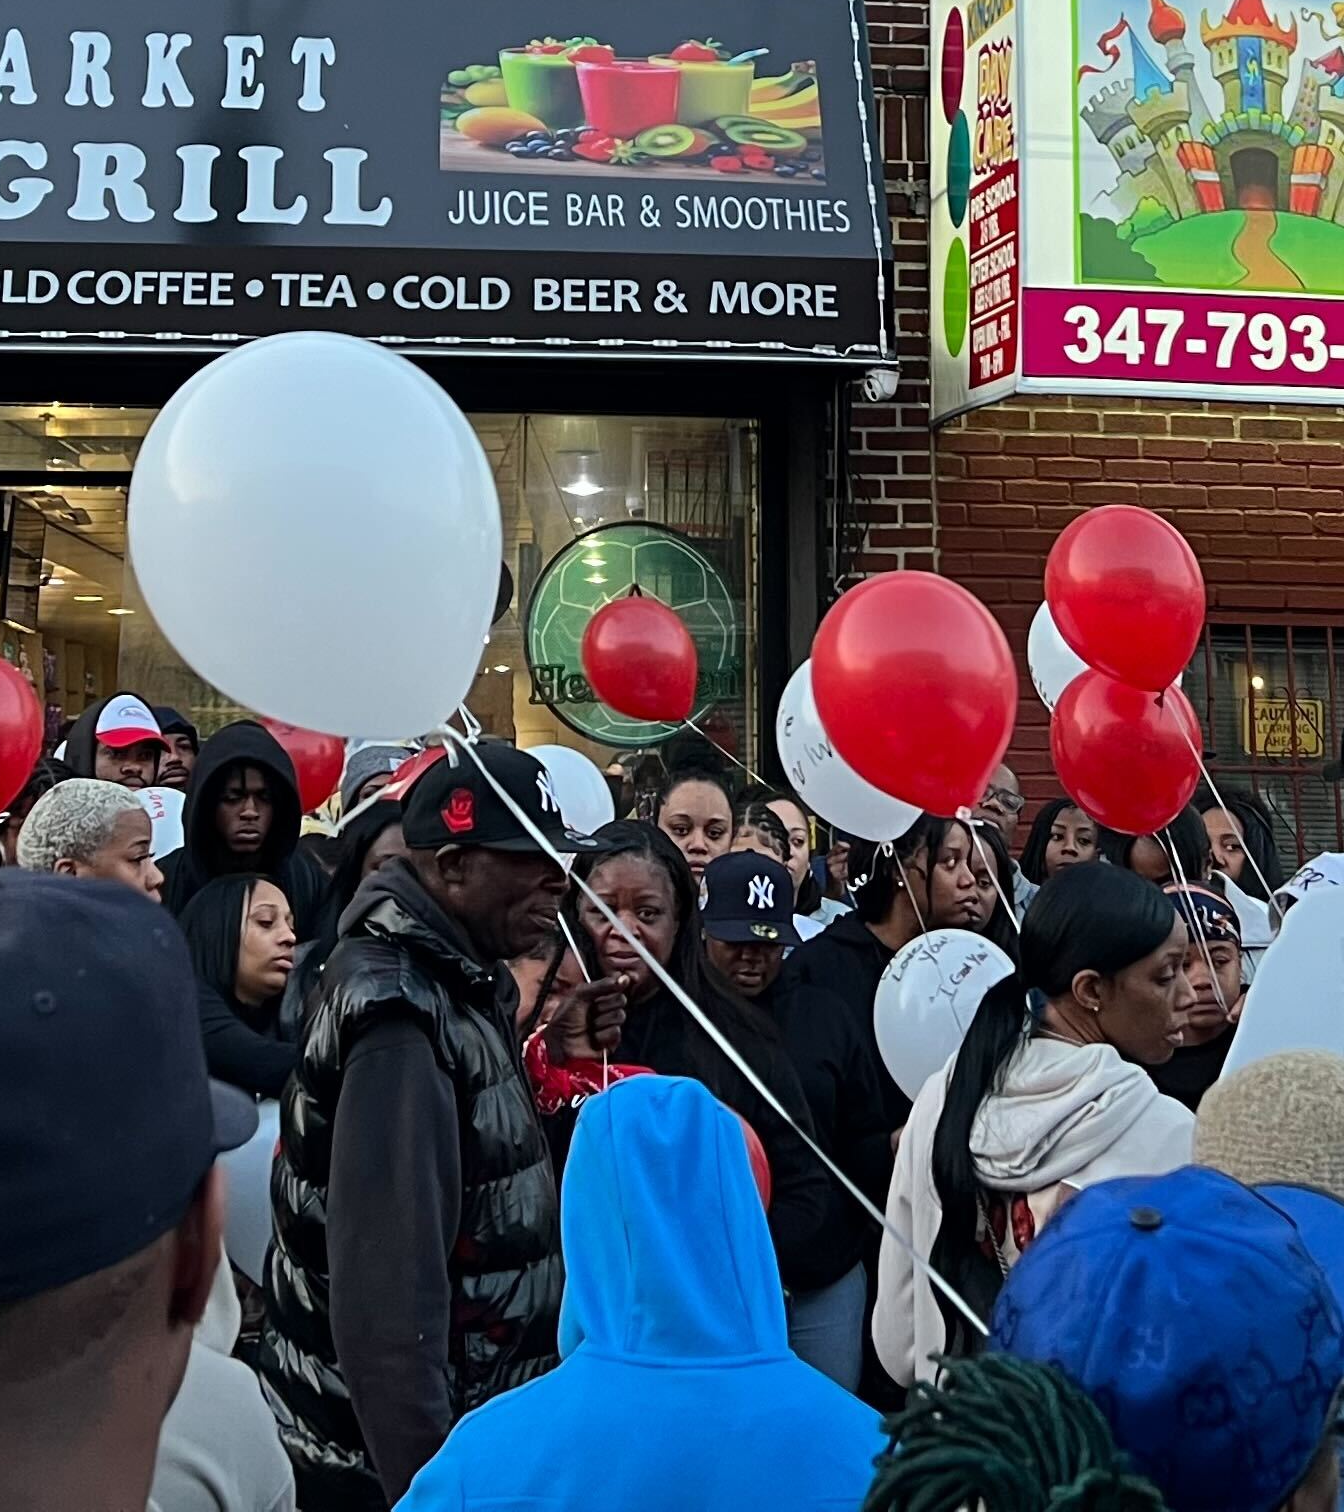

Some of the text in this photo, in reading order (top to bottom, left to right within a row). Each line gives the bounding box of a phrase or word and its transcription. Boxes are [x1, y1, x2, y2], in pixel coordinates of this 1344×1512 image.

[448, 190, 851, 233] JUICE BAR & SMOOTHIES
[67, 271, 234, 306] COFFEE
[272, 272, 357, 308] TEA
[392, 275, 510, 311] COLD
[534, 277, 641, 314] BEER
[654, 280, 688, 315] &
[709, 281, 839, 318] MORE
[1257, 723, 1310, 734] LEARNNG
